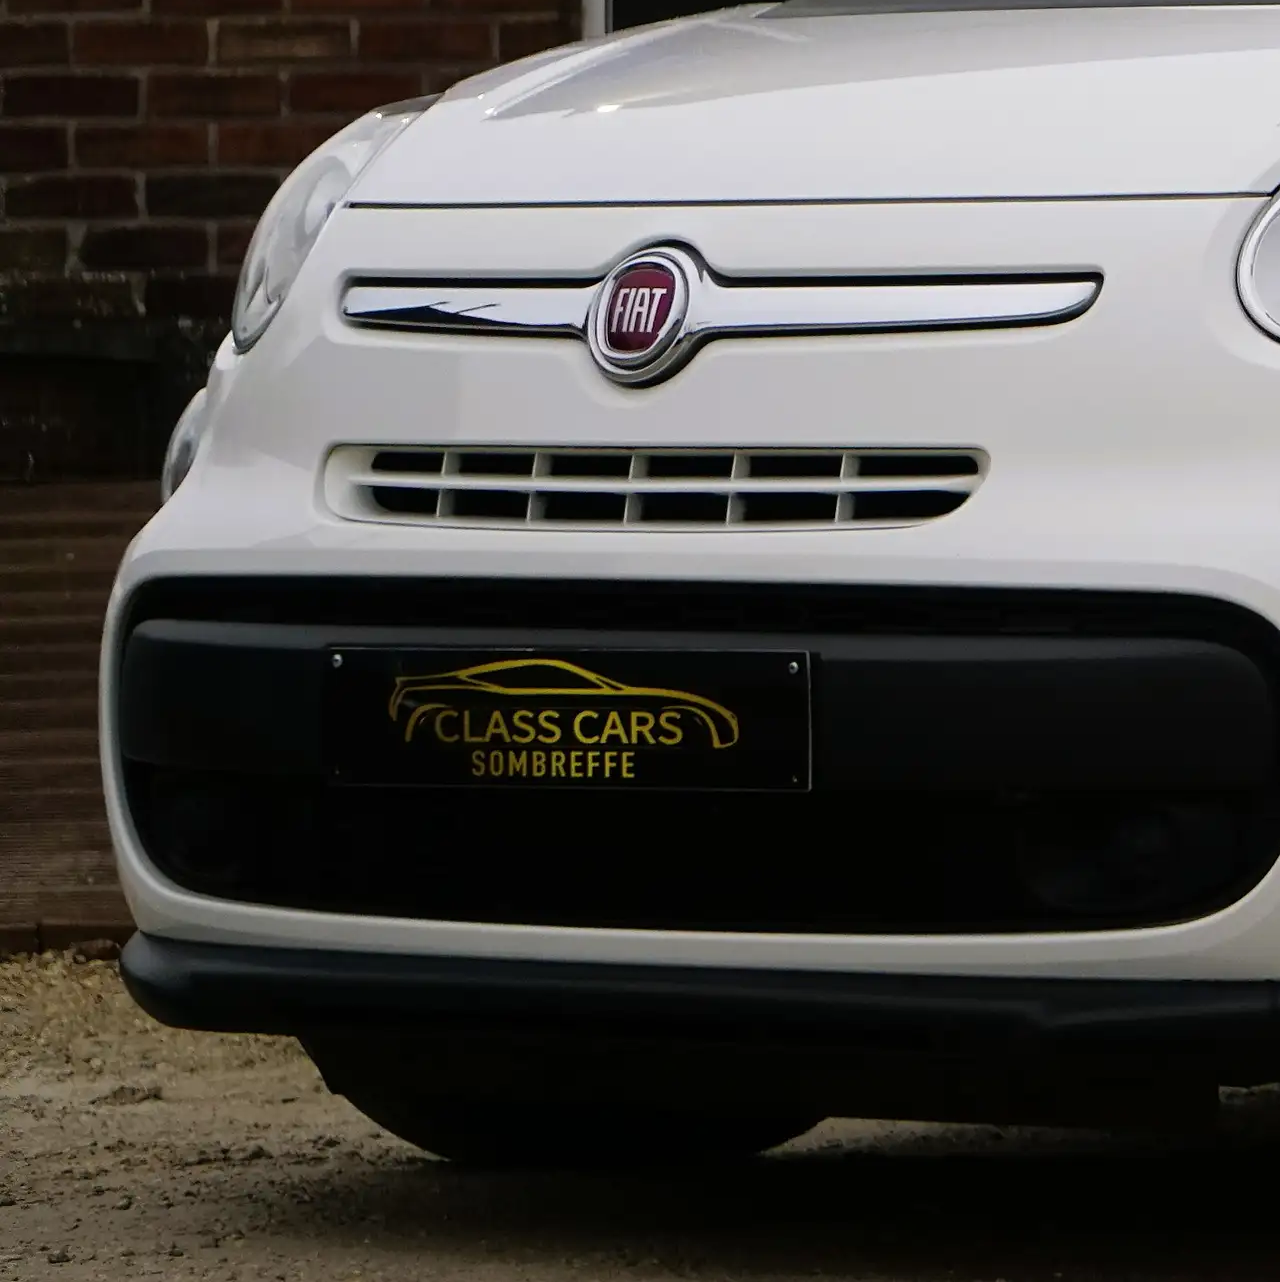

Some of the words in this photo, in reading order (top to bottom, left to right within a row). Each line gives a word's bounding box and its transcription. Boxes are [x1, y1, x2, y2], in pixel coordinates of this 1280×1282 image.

[611, 287, 667, 333] FIAT
[433, 709, 562, 744] CLASS
[573, 710, 684, 745] CARS
[470, 749, 636, 779] SOMBREFFE
